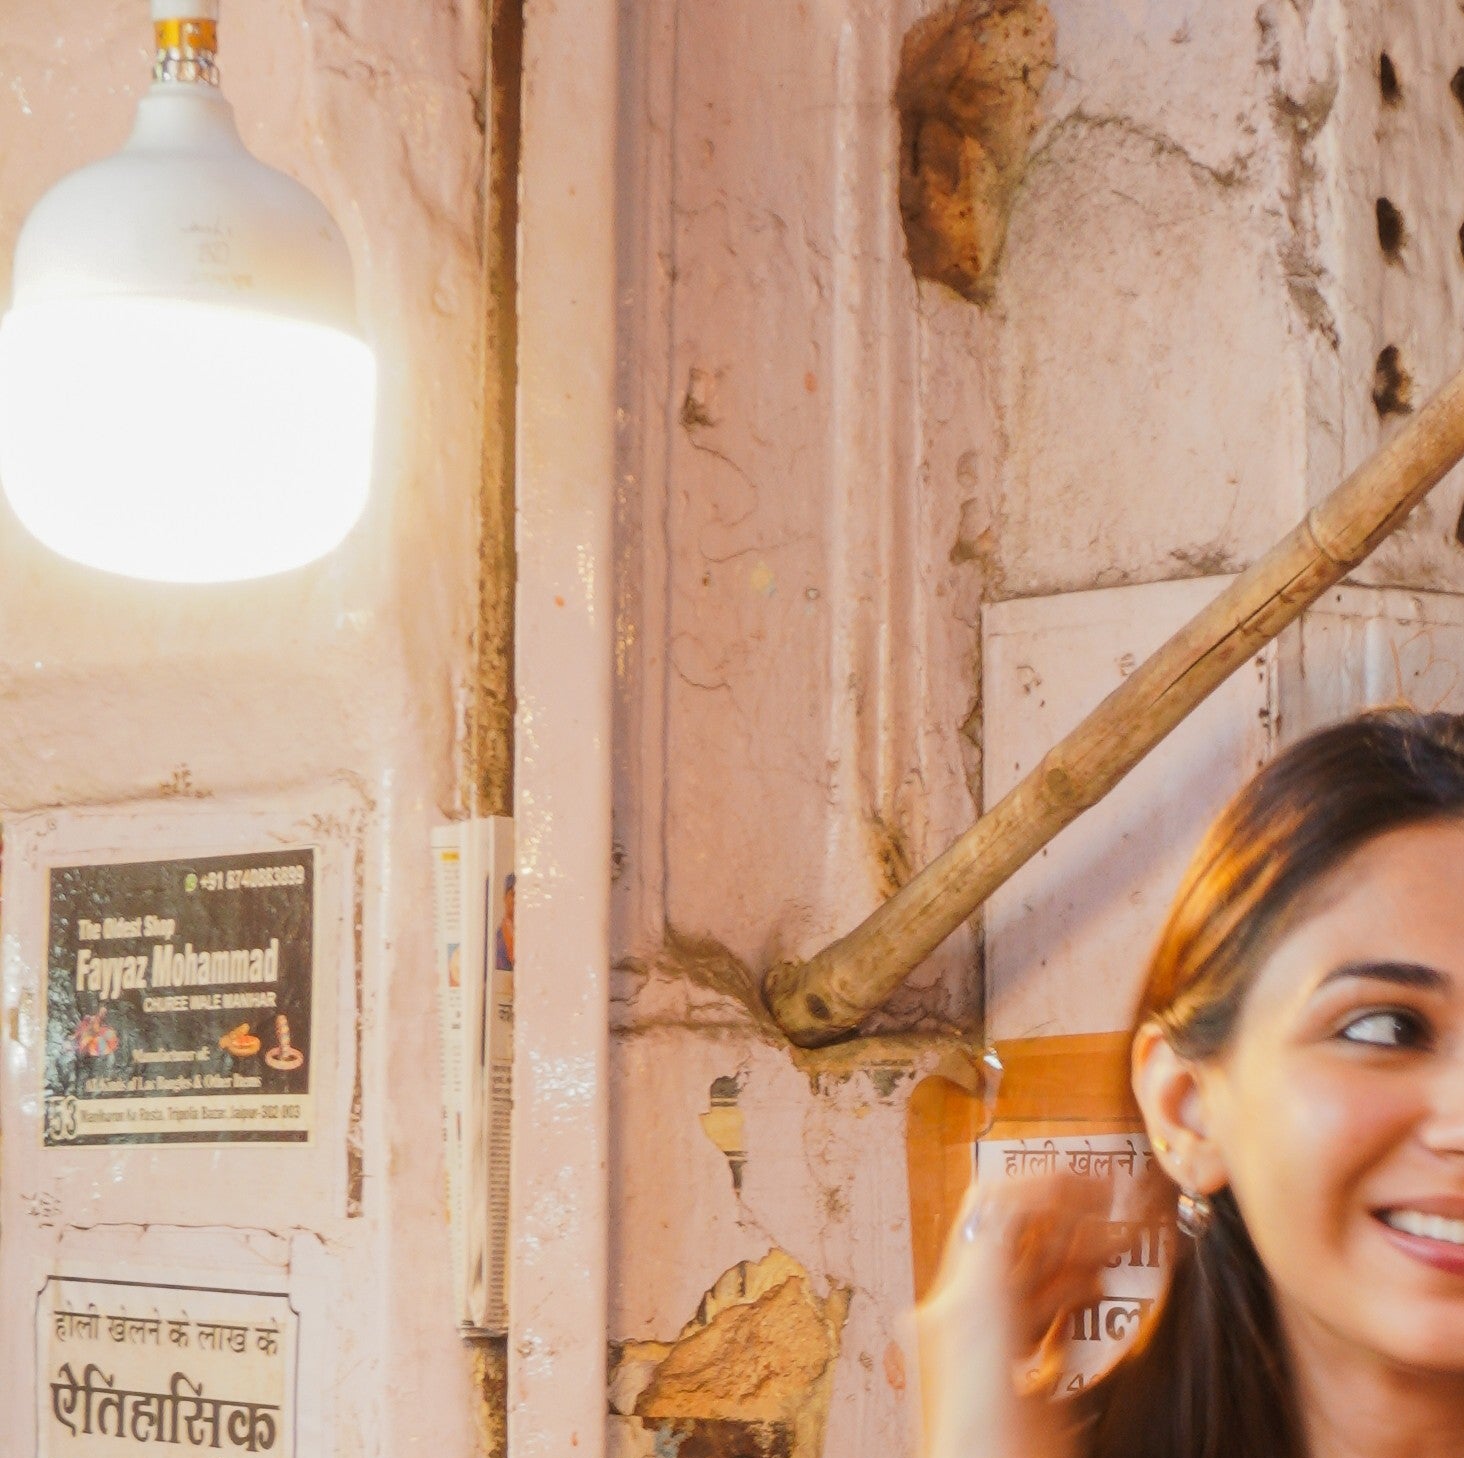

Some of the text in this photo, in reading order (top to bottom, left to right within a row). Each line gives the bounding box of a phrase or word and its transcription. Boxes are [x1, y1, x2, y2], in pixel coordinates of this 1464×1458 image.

[78, 919, 101, 941] The
[143, 915, 175, 940] Shop
[76, 938, 279, 1000] Fayyaz Mohammad
[48, 1098, 78, 1138] 53
[1004, 1139, 1060, 1177] होली
[1066, 1139, 1138, 1178] खेलने
[54, 1301, 280, 1356] होली खेलने के लाख के
[50, 1362, 280, 1452] ऐतिहासिक
